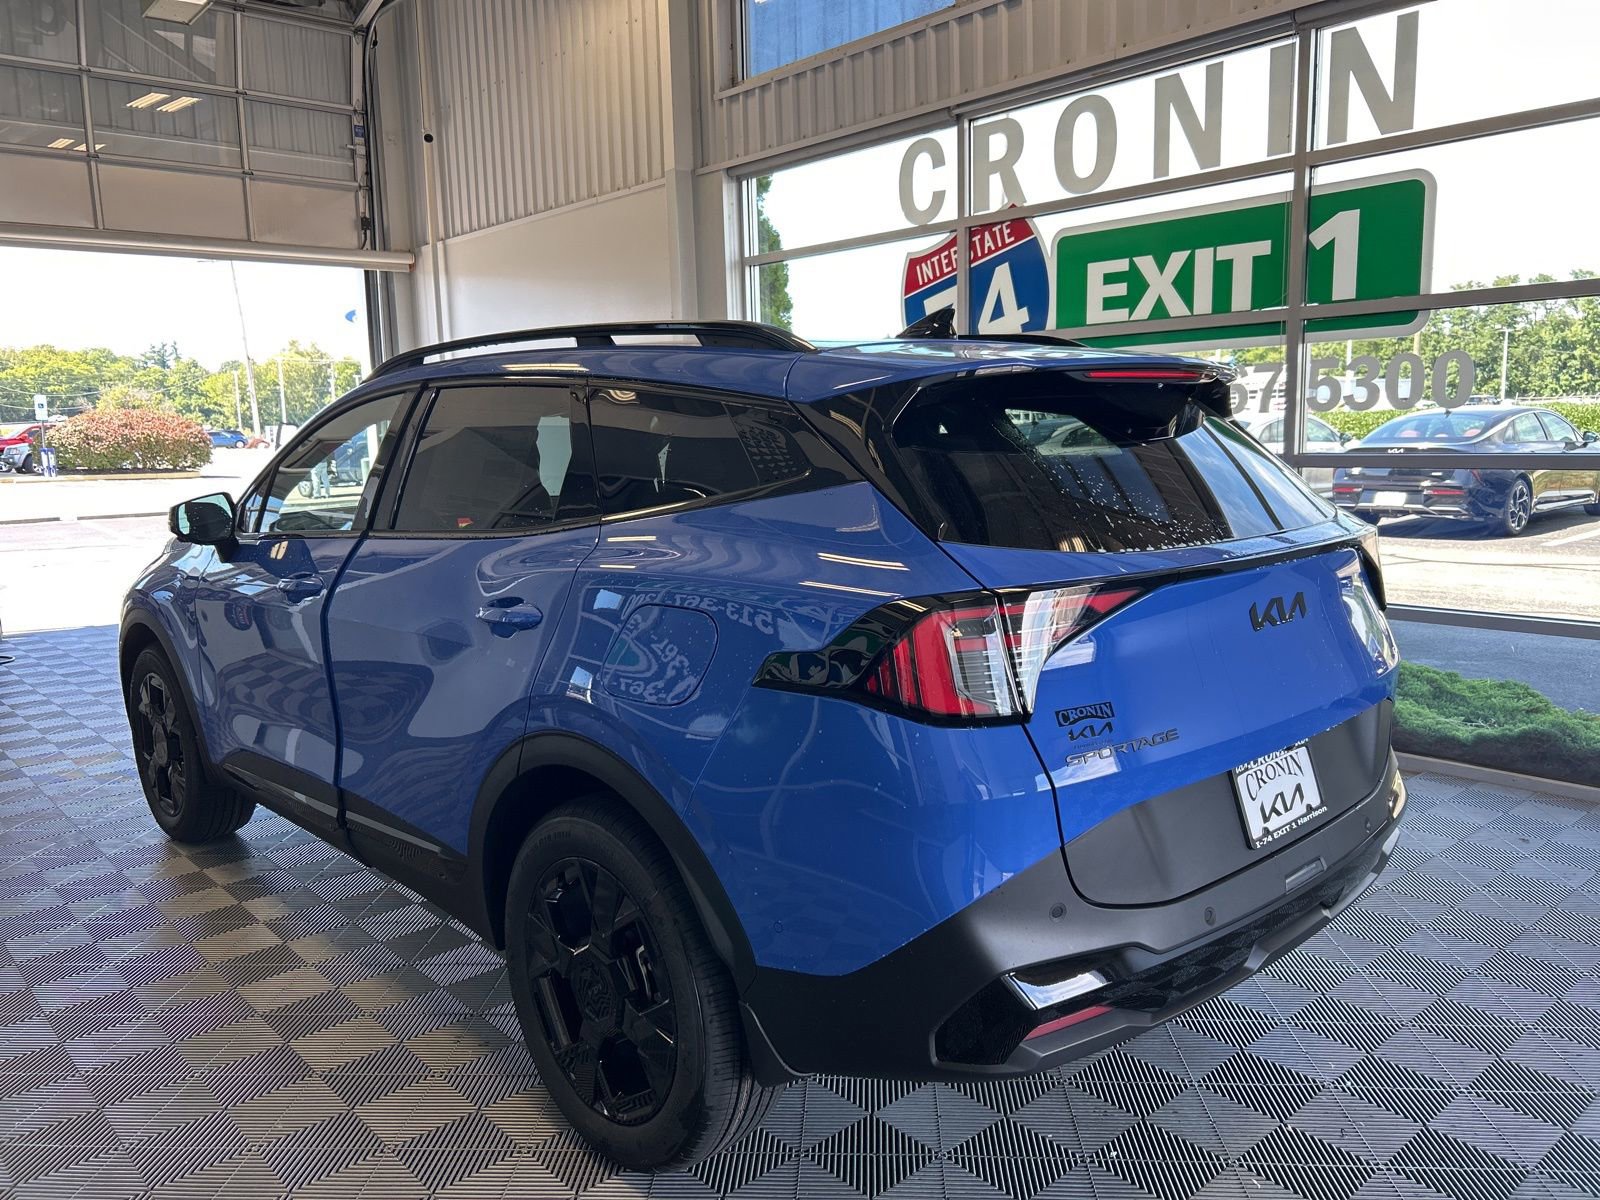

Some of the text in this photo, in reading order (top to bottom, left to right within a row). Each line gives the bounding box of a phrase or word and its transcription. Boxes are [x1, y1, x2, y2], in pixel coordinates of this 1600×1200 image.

[898, 10, 1420, 226] CRONIN
[1086, 209, 1361, 326] EXIT 1
[1249, 591, 1307, 632] KIA
[1058, 702, 1113, 726] CRONIN
[1065, 728, 1180, 768] SPORTAGE
[1245, 751, 1304, 802] CRONIN
[1260, 783, 1305, 825] KIA
[1273, 825, 1291, 839] EXIT
[1297, 805, 1328, 826] Harrison
